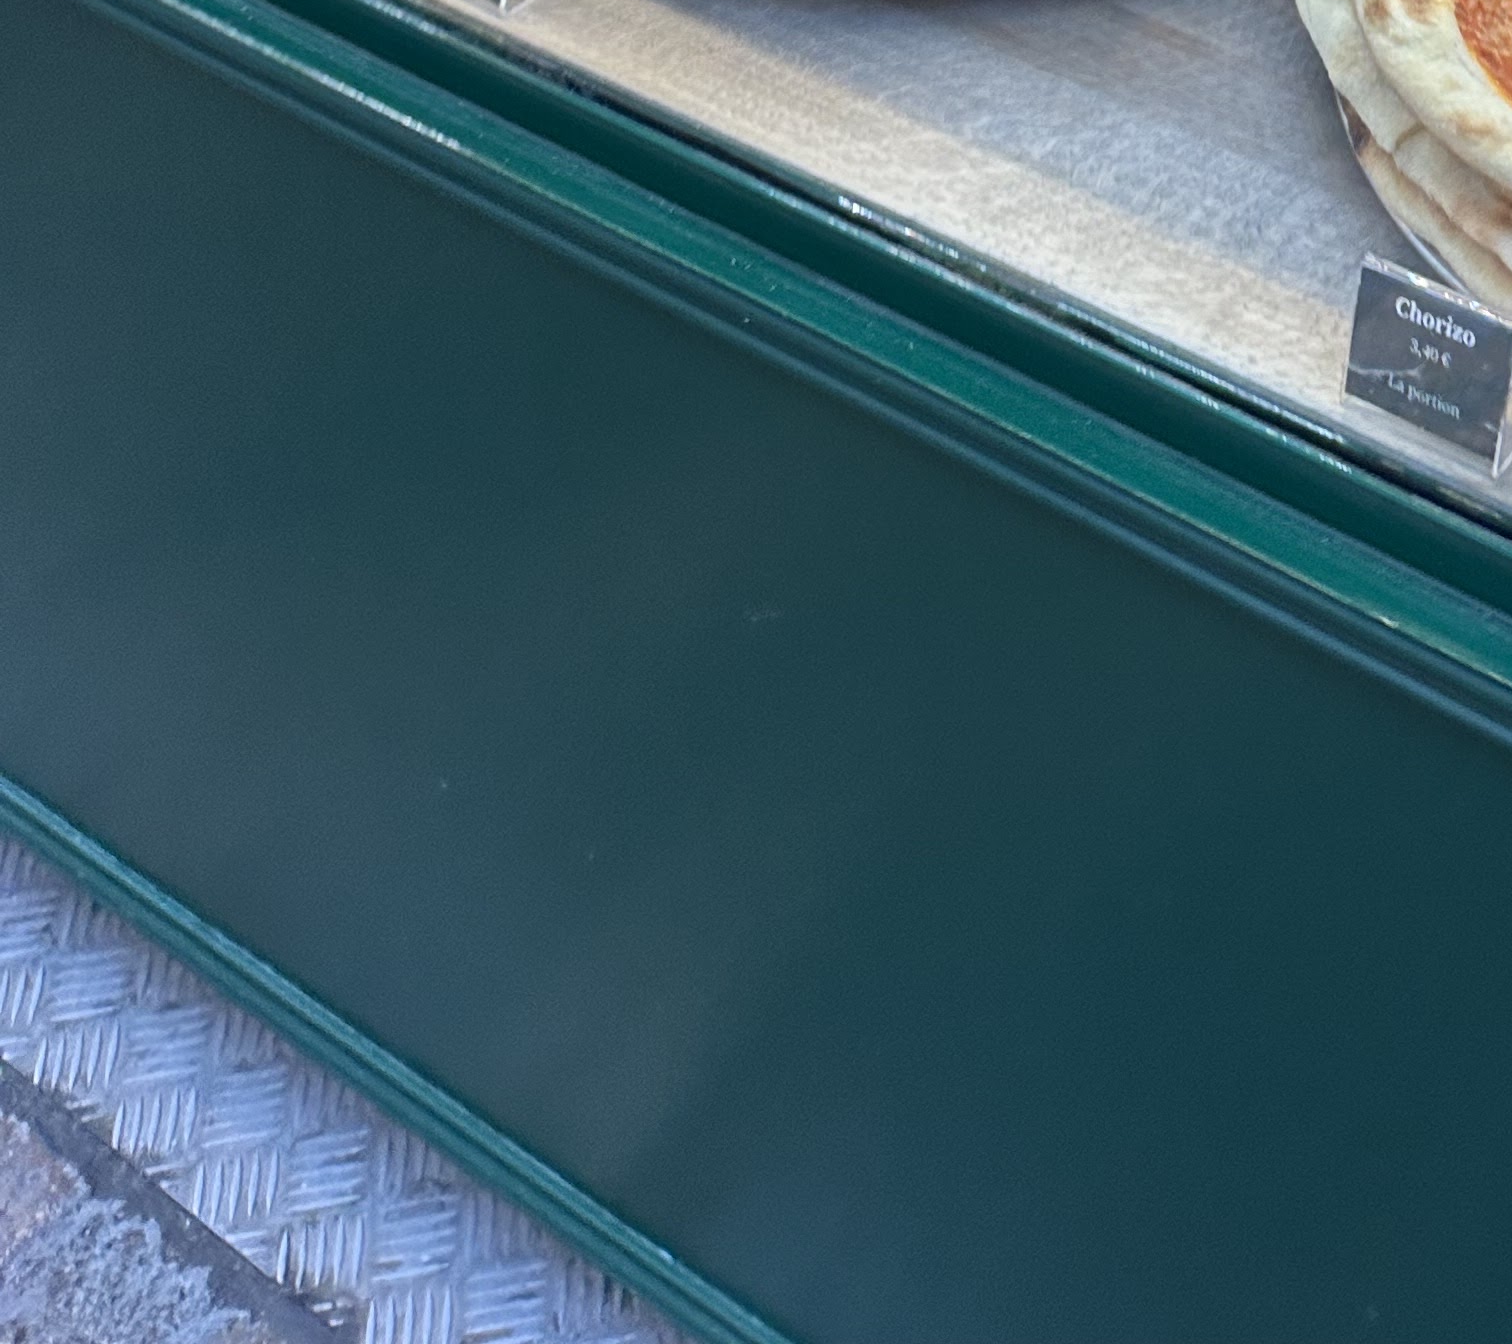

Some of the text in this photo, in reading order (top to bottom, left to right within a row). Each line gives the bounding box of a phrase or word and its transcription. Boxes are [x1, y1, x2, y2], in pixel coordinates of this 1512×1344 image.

[1395, 295, 1477, 349] Chorizo
[1387, 372, 1460, 421] La portion
